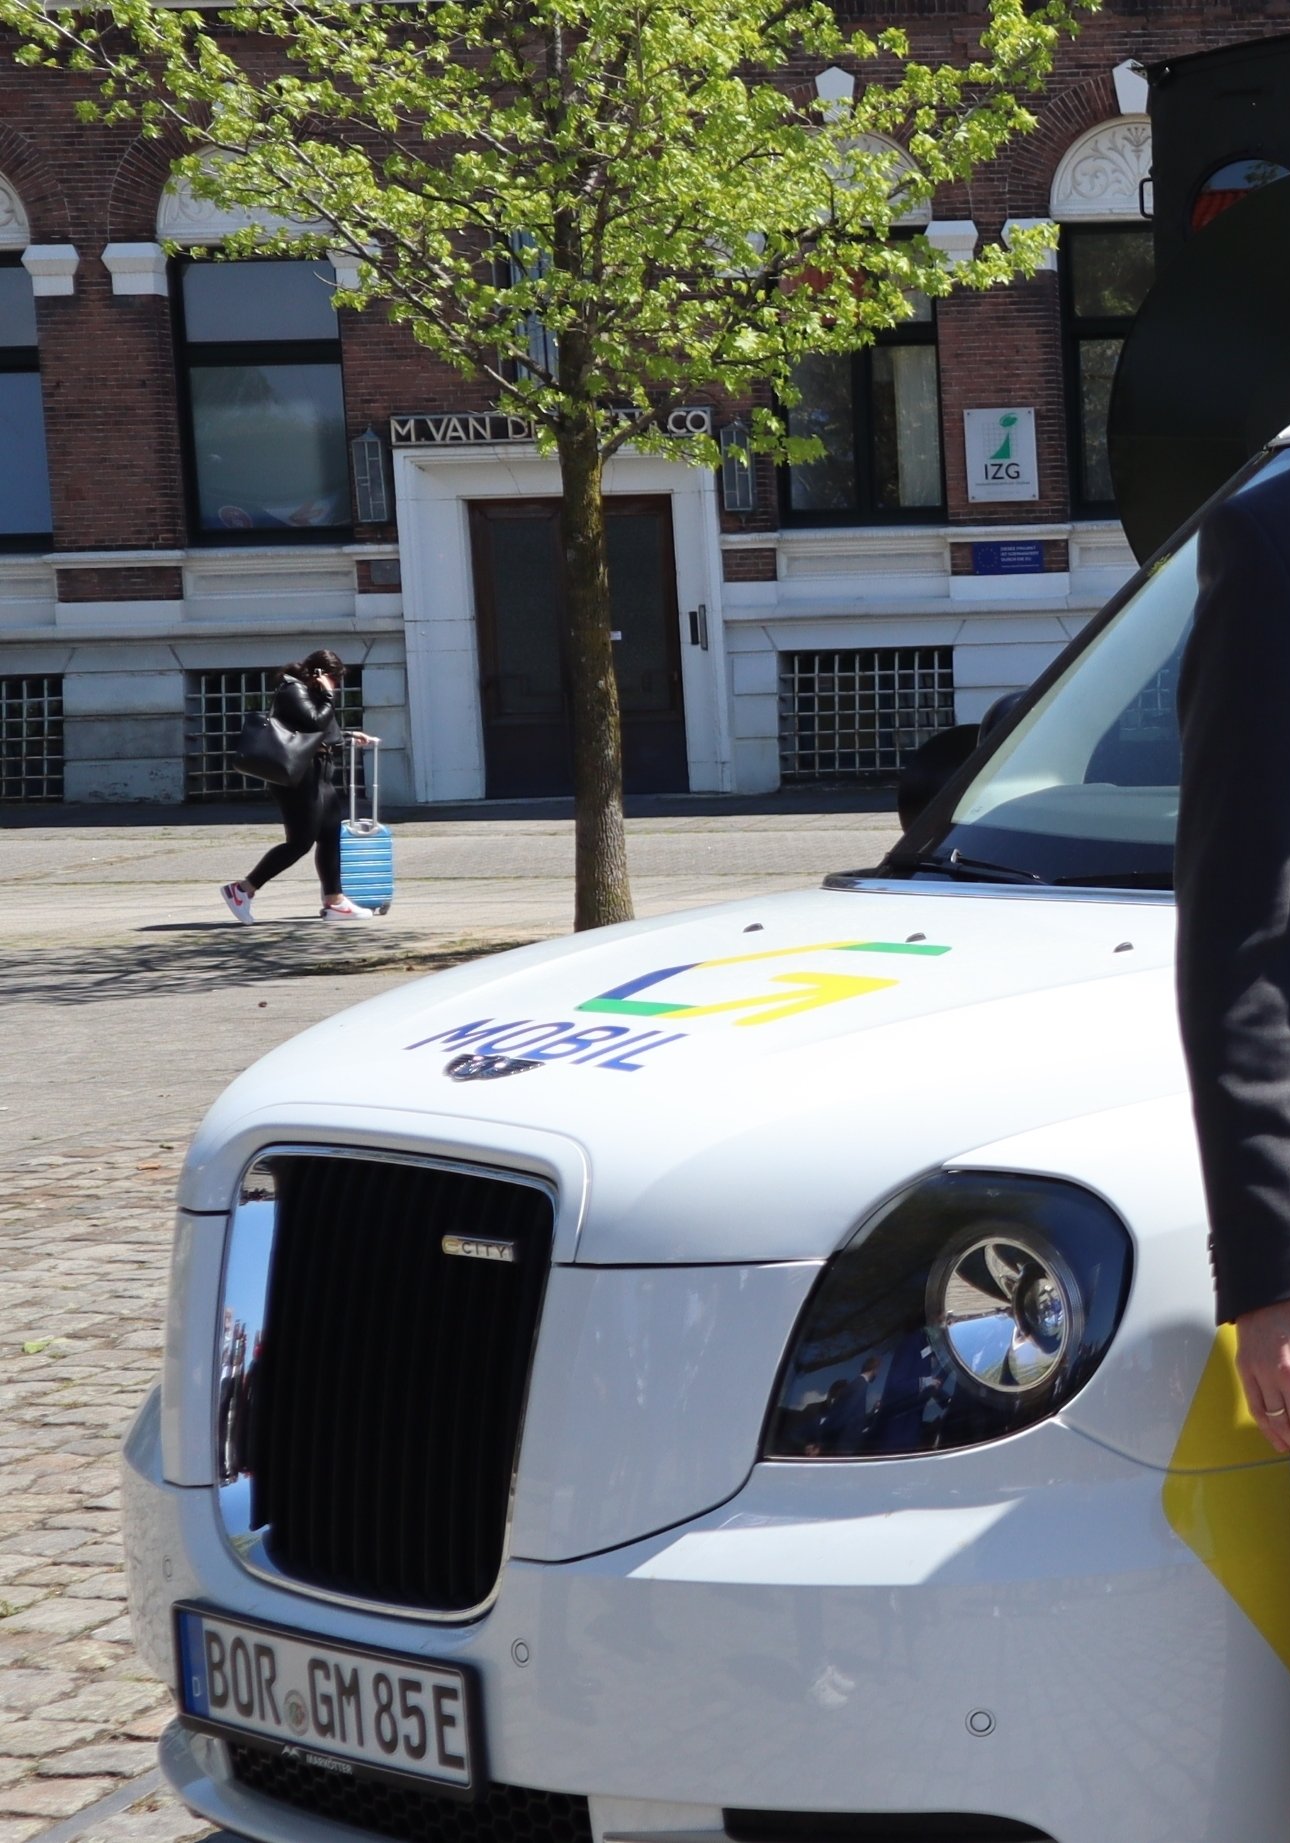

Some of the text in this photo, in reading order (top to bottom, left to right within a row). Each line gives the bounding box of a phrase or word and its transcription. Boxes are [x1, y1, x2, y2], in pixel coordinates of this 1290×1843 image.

[668, 410, 709, 433] CO
[984, 462, 1020, 480] IZG
[402, 1018, 689, 1073] MOBIL
[204, 1629, 282, 1725] BOR
[307, 1657, 365, 1748] GM
